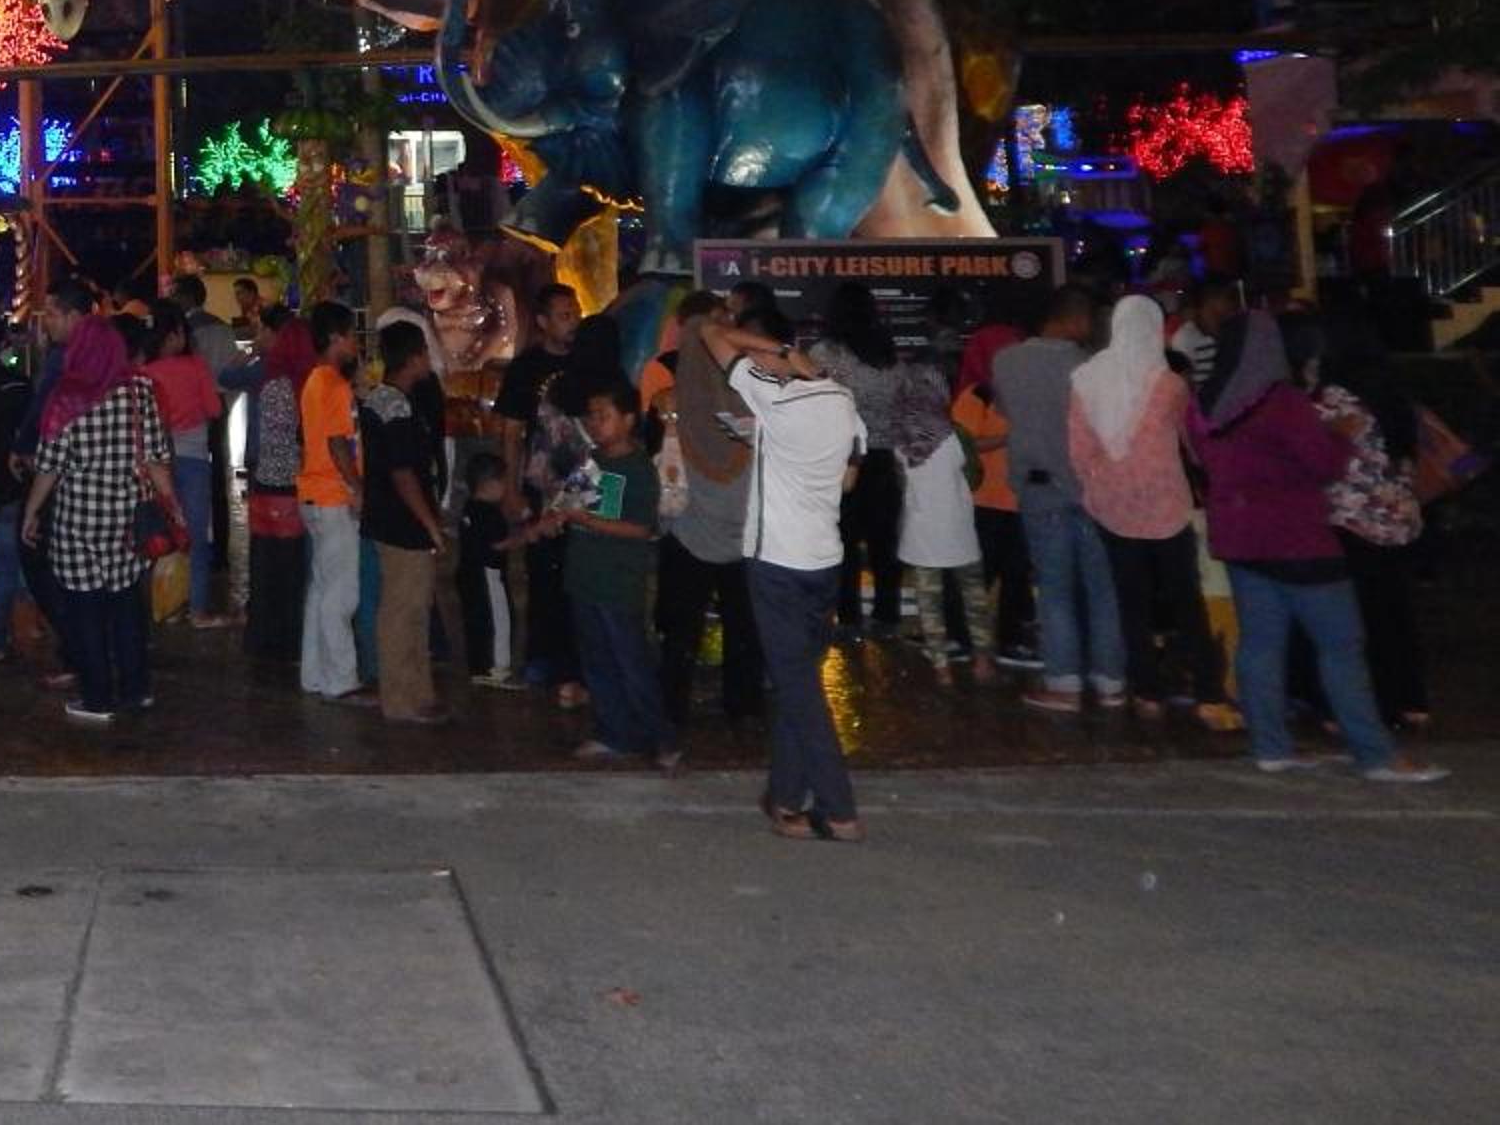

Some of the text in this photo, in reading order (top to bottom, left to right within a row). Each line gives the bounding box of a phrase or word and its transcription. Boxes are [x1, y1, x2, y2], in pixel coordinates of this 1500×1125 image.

[751, 254, 1010, 277] i-CITY LEISURE PARK
